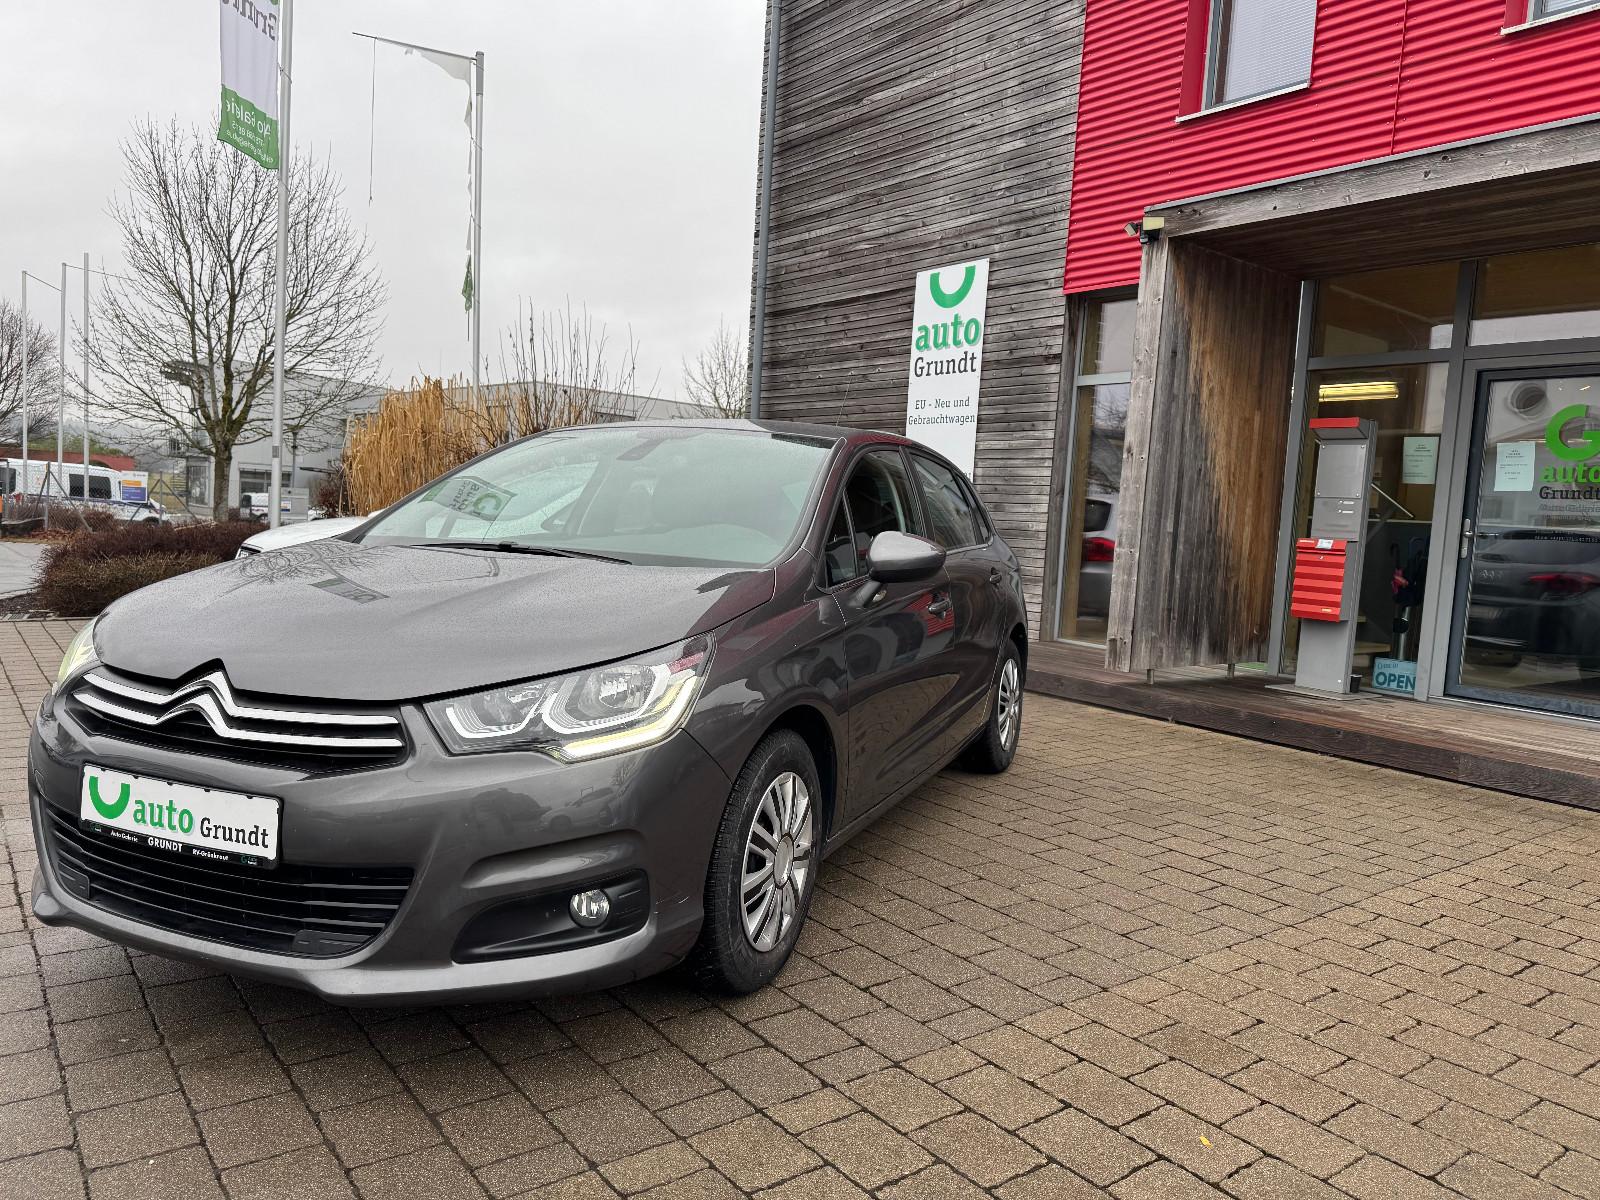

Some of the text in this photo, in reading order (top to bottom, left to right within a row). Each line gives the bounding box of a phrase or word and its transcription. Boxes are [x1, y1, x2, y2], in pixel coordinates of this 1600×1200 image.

[915, 313, 981, 351] auto
[914, 351, 977, 377] Grundt
[915, 399, 926, 409] EU
[934, 398, 951, 408] Neu
[953, 396, 970, 407] und
[908, 413, 976, 426] Gebrauchtwagen
[1540, 463, 1600, 483] auto
[1376, 671, 1416, 690] OPEN
[133, 799, 268, 848] auto Grundt
[147, 836, 183, 853] GRUNDT
